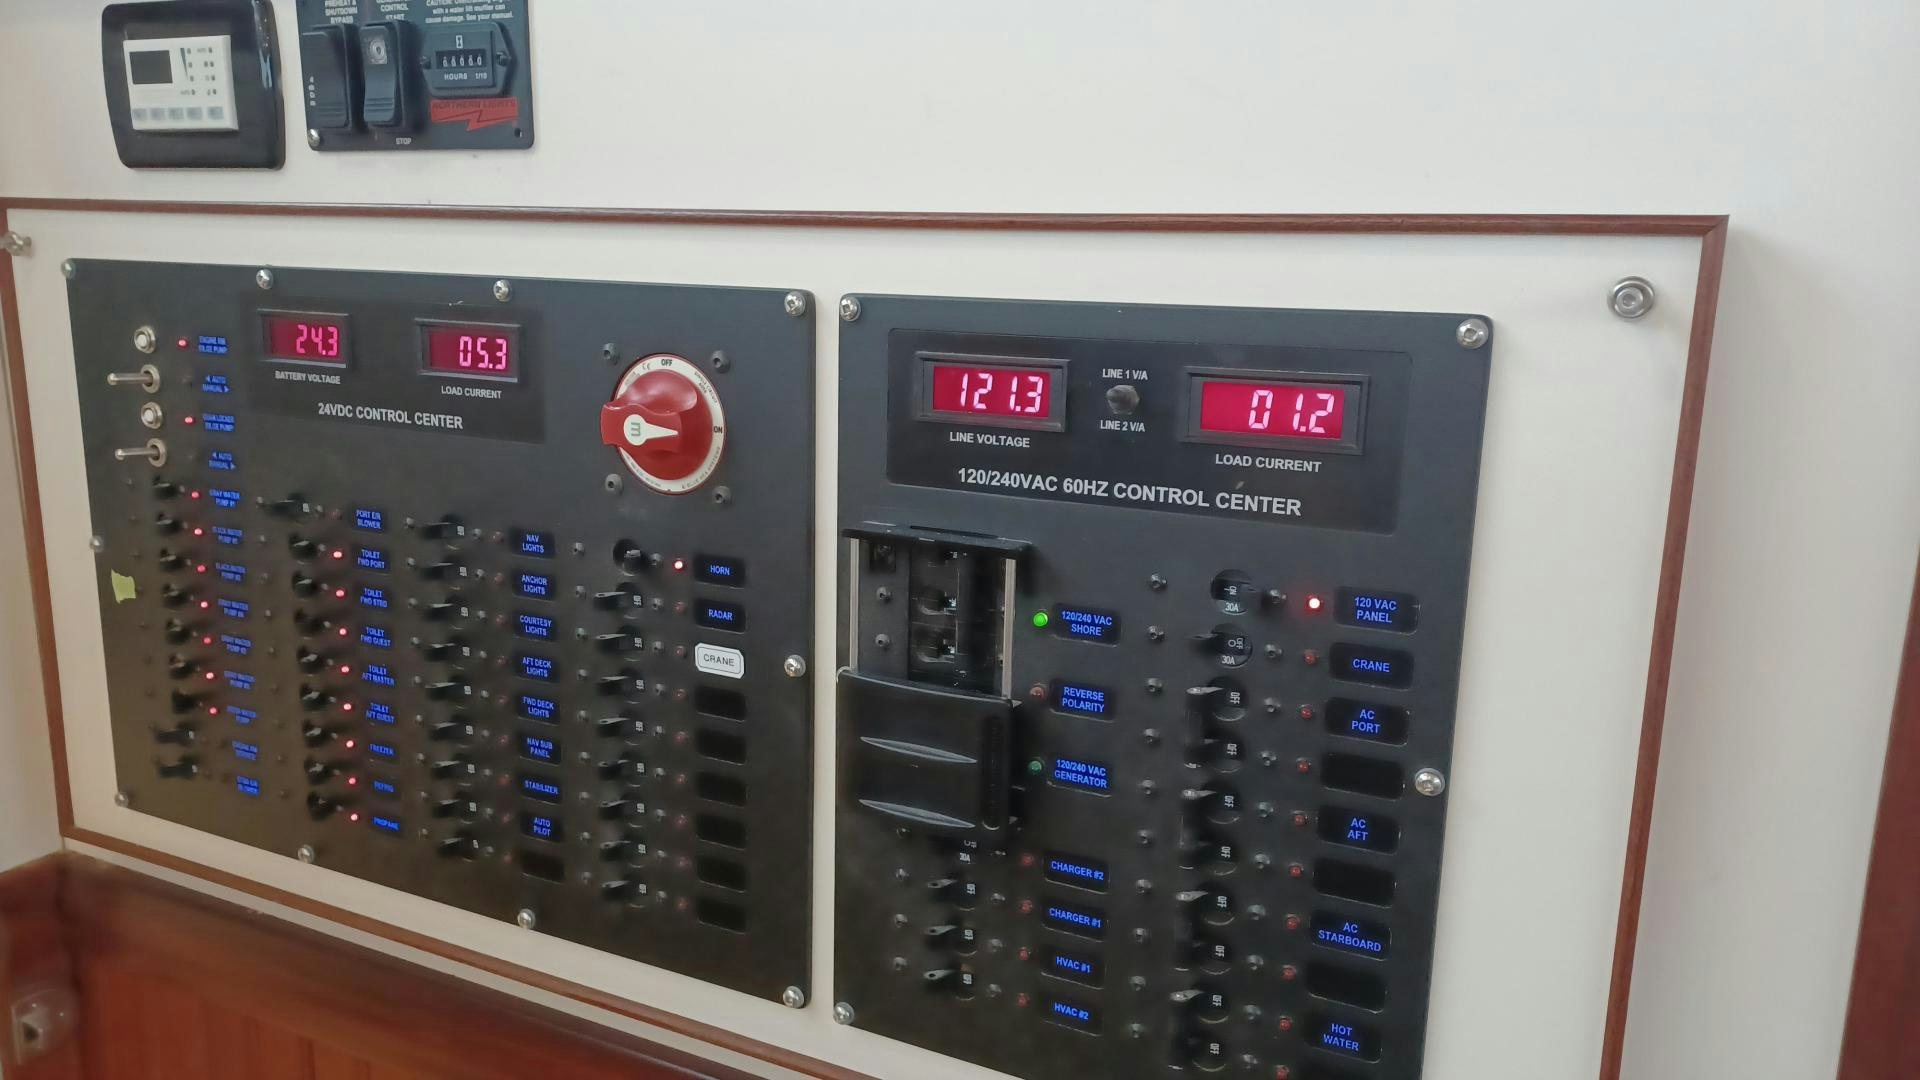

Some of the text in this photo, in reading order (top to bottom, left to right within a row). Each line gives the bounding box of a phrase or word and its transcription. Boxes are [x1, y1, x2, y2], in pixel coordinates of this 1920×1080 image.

[325, 6, 357, 16] SHUTDOWN
[381, 3, 408, 12] CONTROL
[331, 15, 353, 24] BYPASS
[444, 72, 468, 80] HOURS
[395, 137, 412, 145] STOP
[296, 324, 338, 356] 24.3
[459, 335, 507, 370] 05.3
[661, 359, 673, 367] OFF
[275, 370, 341, 385] BATTERY VOLTAGE
[1102, 368, 1148, 380] LINE 1 V/A
[441, 385, 502, 399] LOAD CURRENT
[960, 372, 1044, 413] 121.3
[318, 402, 463, 429] 24VDC CONTROL CENTER
[1248, 389, 1336, 434] 01.2
[713, 426, 723, 434] ON
[1100, 420, 1146, 432] LINE 2 V/A
[950, 432, 1030, 448] LINE VOLTAGE
[1215, 453, 1322, 473] LOAD CURRENT
[958, 467, 1302, 517] 120/240VAC 60HZ CONTROL CENTER
[356, 509, 371, 520] PORT
[357, 519, 382, 529] BLOWER
[526, 533, 540, 543] NAV
[361, 549, 380, 559] TOILET
[522, 543, 544, 554] LIGHTS
[357, 557, 385, 569] FWD PORT
[710, 565, 730, 576] HORN
[521, 574, 547, 586] ANCHOR
[364, 588, 382, 598] TOILET
[524, 584, 546, 595] LIGHTS
[1225, 602, 1239, 612] 30A
[1354, 597, 1396, 611] 120 VAC
[519, 615, 552, 627] COURTESY
[708, 608, 733, 621] RADAR
[1061, 610, 1112, 626] 120/240 VAC
[1356, 610, 1392, 623] PANEL
[366, 626, 385, 637] TOILET
[525, 625, 547, 636] LIGHTS
[1071, 623, 1102, 636] SHORE
[373, 636, 391, 647] GUEST
[1236, 637, 1244, 650] OFF
[522, 656, 552, 669] AFT DECK
[703, 653, 735, 667] CRANE
[1221, 655, 1235, 665] 30A
[1352, 659, 1390, 673] CRANE
[368, 665, 387, 675] TOILET
[526, 666, 548, 677] LIGHTS
[372, 674, 395, 686] MASTER
[1063, 686, 1104, 701] REVERSE
[1230, 691, 1240, 705] OFF
[522, 696, 554, 710] FWD DECK
[1062, 698, 1105, 712] POLARITY
[528, 707, 550, 718] LIGHTS
[1359, 709, 1375, 720] AC
[1351, 721, 1380, 734] PORT
[526, 737, 553, 750] NAV SUB
[1227, 743, 1237, 756] OFF
[530, 746, 551, 758] PANEL
[1056, 759, 1106, 777] 120/240 VAC
[1054, 770, 1107, 788] GENERATOR
[524, 780, 560, 795] STABILIZER
[1224, 795, 1234, 808] OFF
[533, 816, 551, 828] AUTO
[1350, 817, 1366, 829] AC
[533, 825, 551, 837] PILOT
[1347, 829, 1368, 841] AFT
[1221, 846, 1231, 859] OFF
[1051, 860, 1104, 880] CHARGER #2
[1217, 895, 1227, 909] OFF
[1049, 907, 1101, 928] CHARGER #1
[1343, 922, 1358, 933] AC
[1318, 929, 1382, 952] STARBOARD
[1215, 944, 1225, 957] OFF
[1055, 956, 1091, 973] HVAC #1
[1212, 994, 1222, 1007] OFF
[1054, 1002, 1089, 1020] HVAC #2
[1331, 1023, 1352, 1036] HOT
[1209, 1043, 1219, 1055] OFF
[1323, 1034, 1359, 1051] WATER
